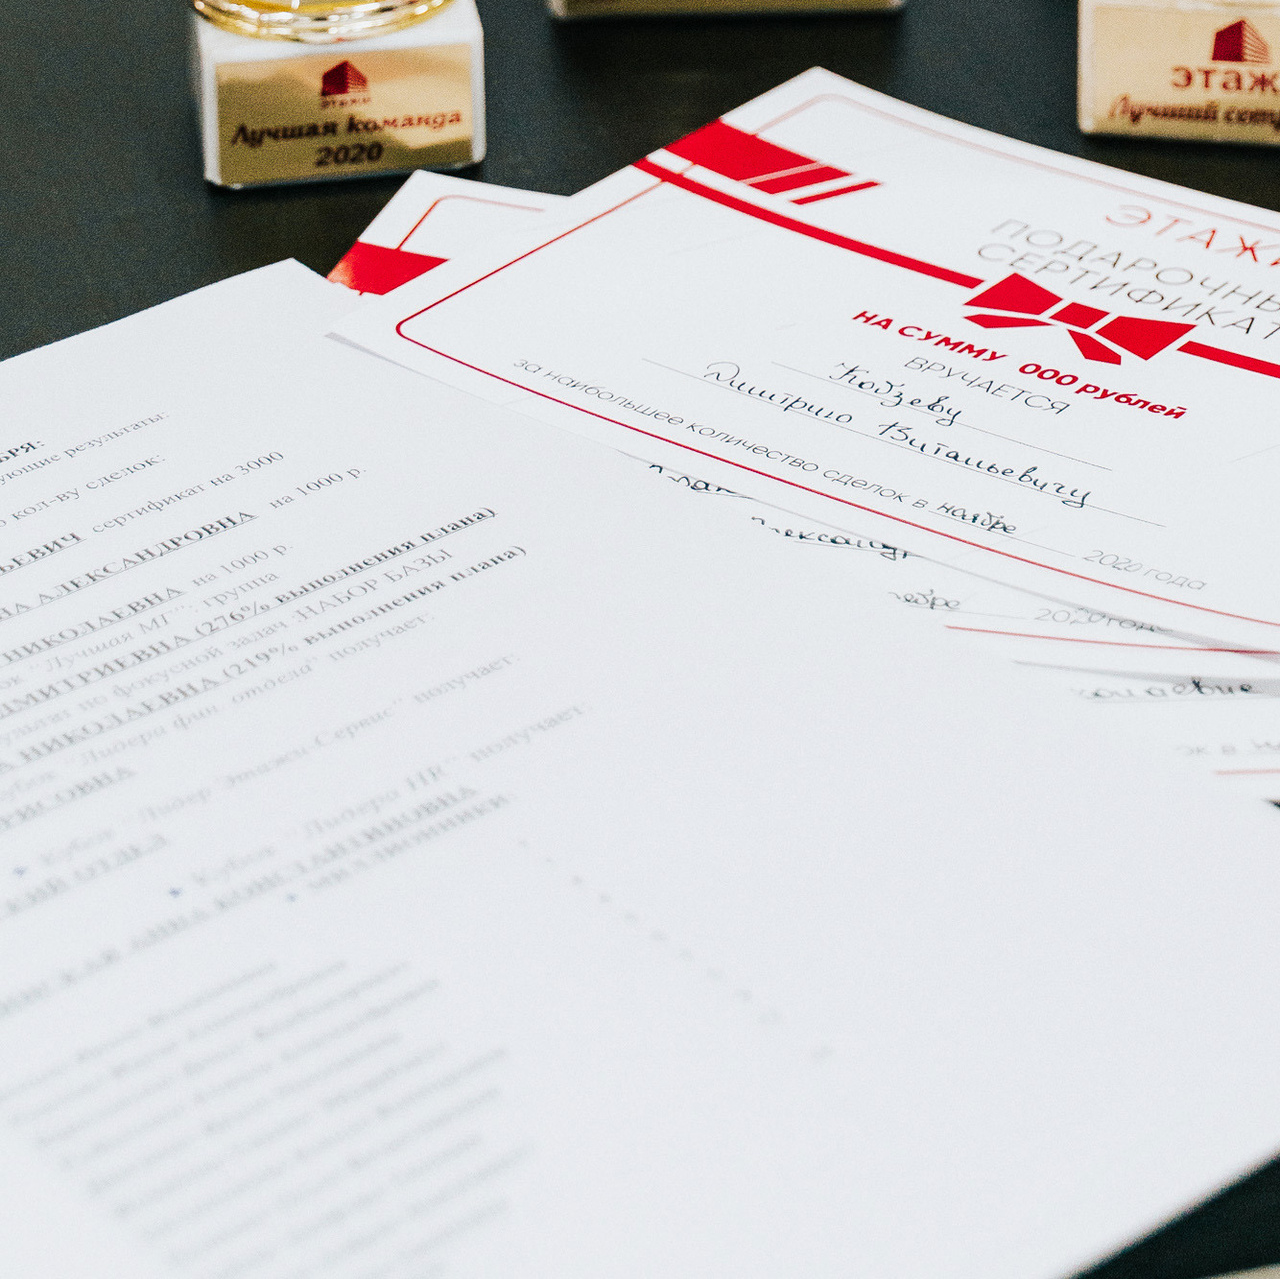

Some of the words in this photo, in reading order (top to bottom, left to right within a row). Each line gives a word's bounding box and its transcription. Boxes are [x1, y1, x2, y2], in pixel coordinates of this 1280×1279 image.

[316, 142, 383, 167] 2020
[852, 310, 894, 330] НА
[898, 324, 1009, 362] СУММУ
[1018, 362, 1079, 387] 000
[1074, 383, 1188, 420] рублей
[903, 355, 1072, 415] ВРУЧАЕТСЯ
[10, 485, 81, 523] кол-ву
[84, 452, 165, 492] сделок:
[90, 483, 207, 535] сертификат
[208, 472, 235, 488] на
[235, 449, 285, 476] 3000
[513, 358, 544, 374] за
[543, 370, 685, 427] наибольшее
[686, 421, 820, 473] количество
[821, 467, 910, 504] сделок
[912, 496, 928, 510] в
[1142, 565, 1209, 592] года
